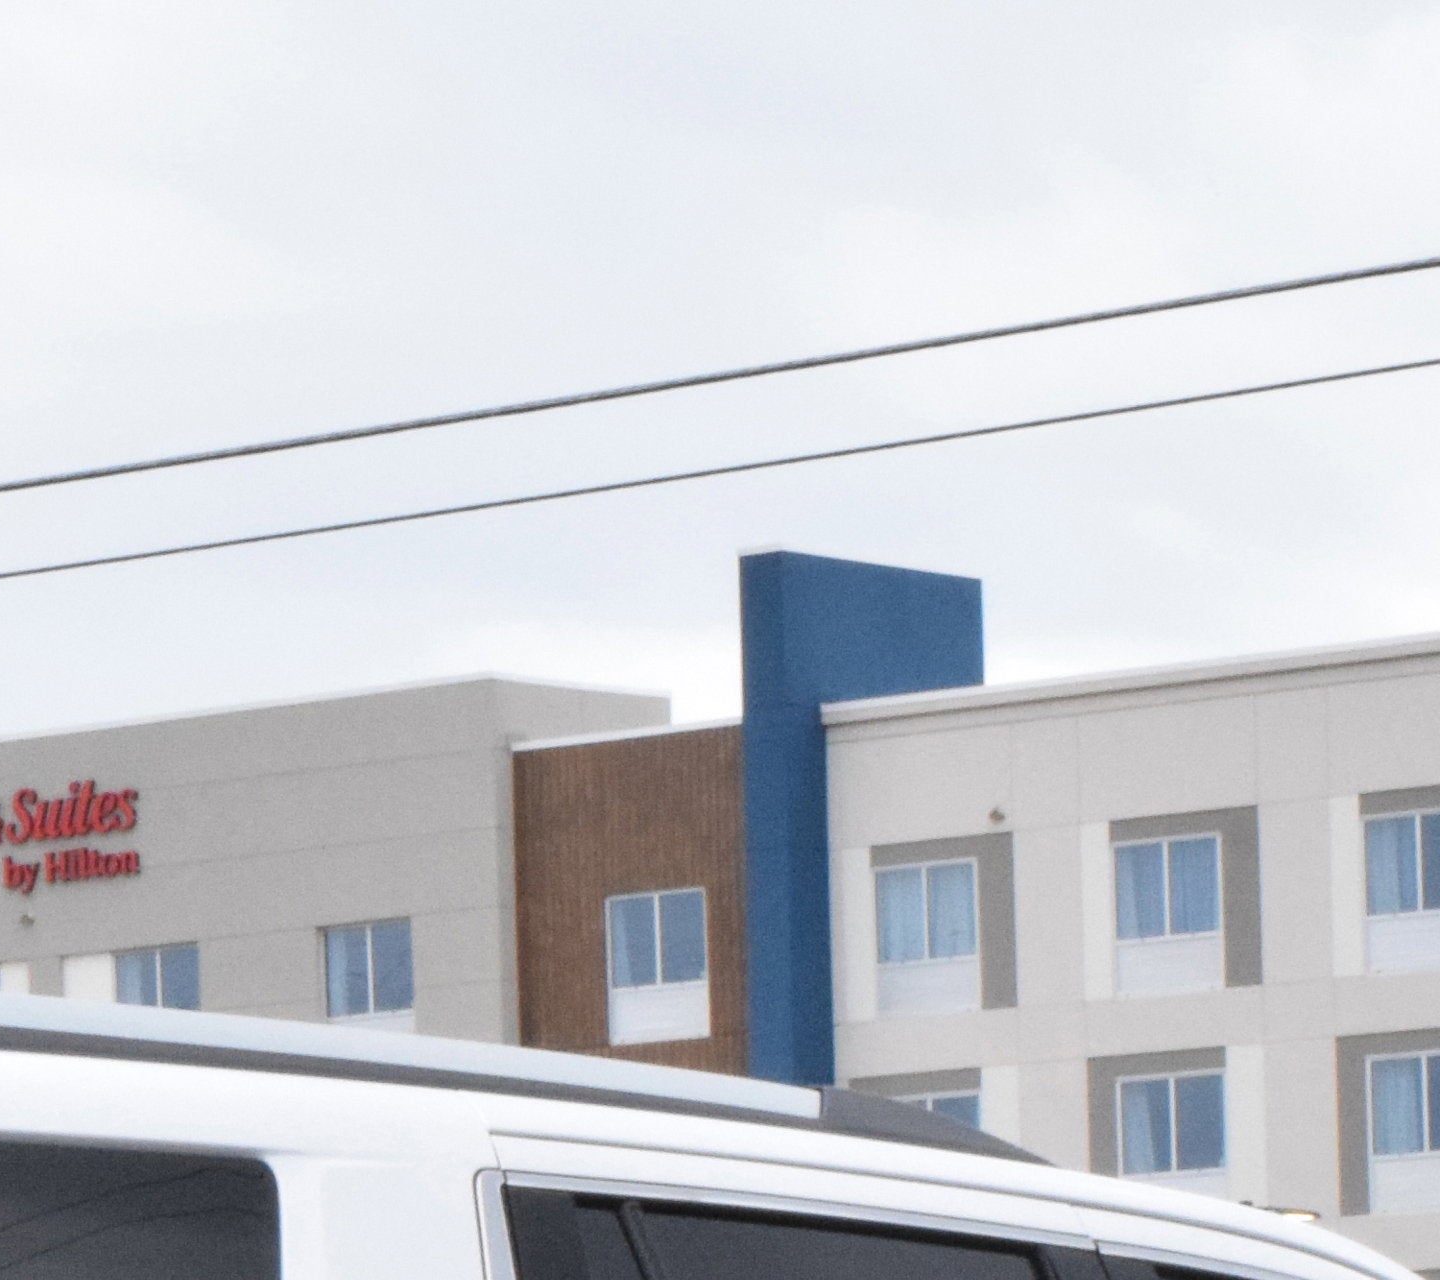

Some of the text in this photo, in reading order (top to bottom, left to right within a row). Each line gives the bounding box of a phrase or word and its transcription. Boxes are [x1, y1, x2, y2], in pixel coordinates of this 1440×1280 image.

[6, 779, 138, 844] Suites
[3, 849, 140, 894] by Hilton
